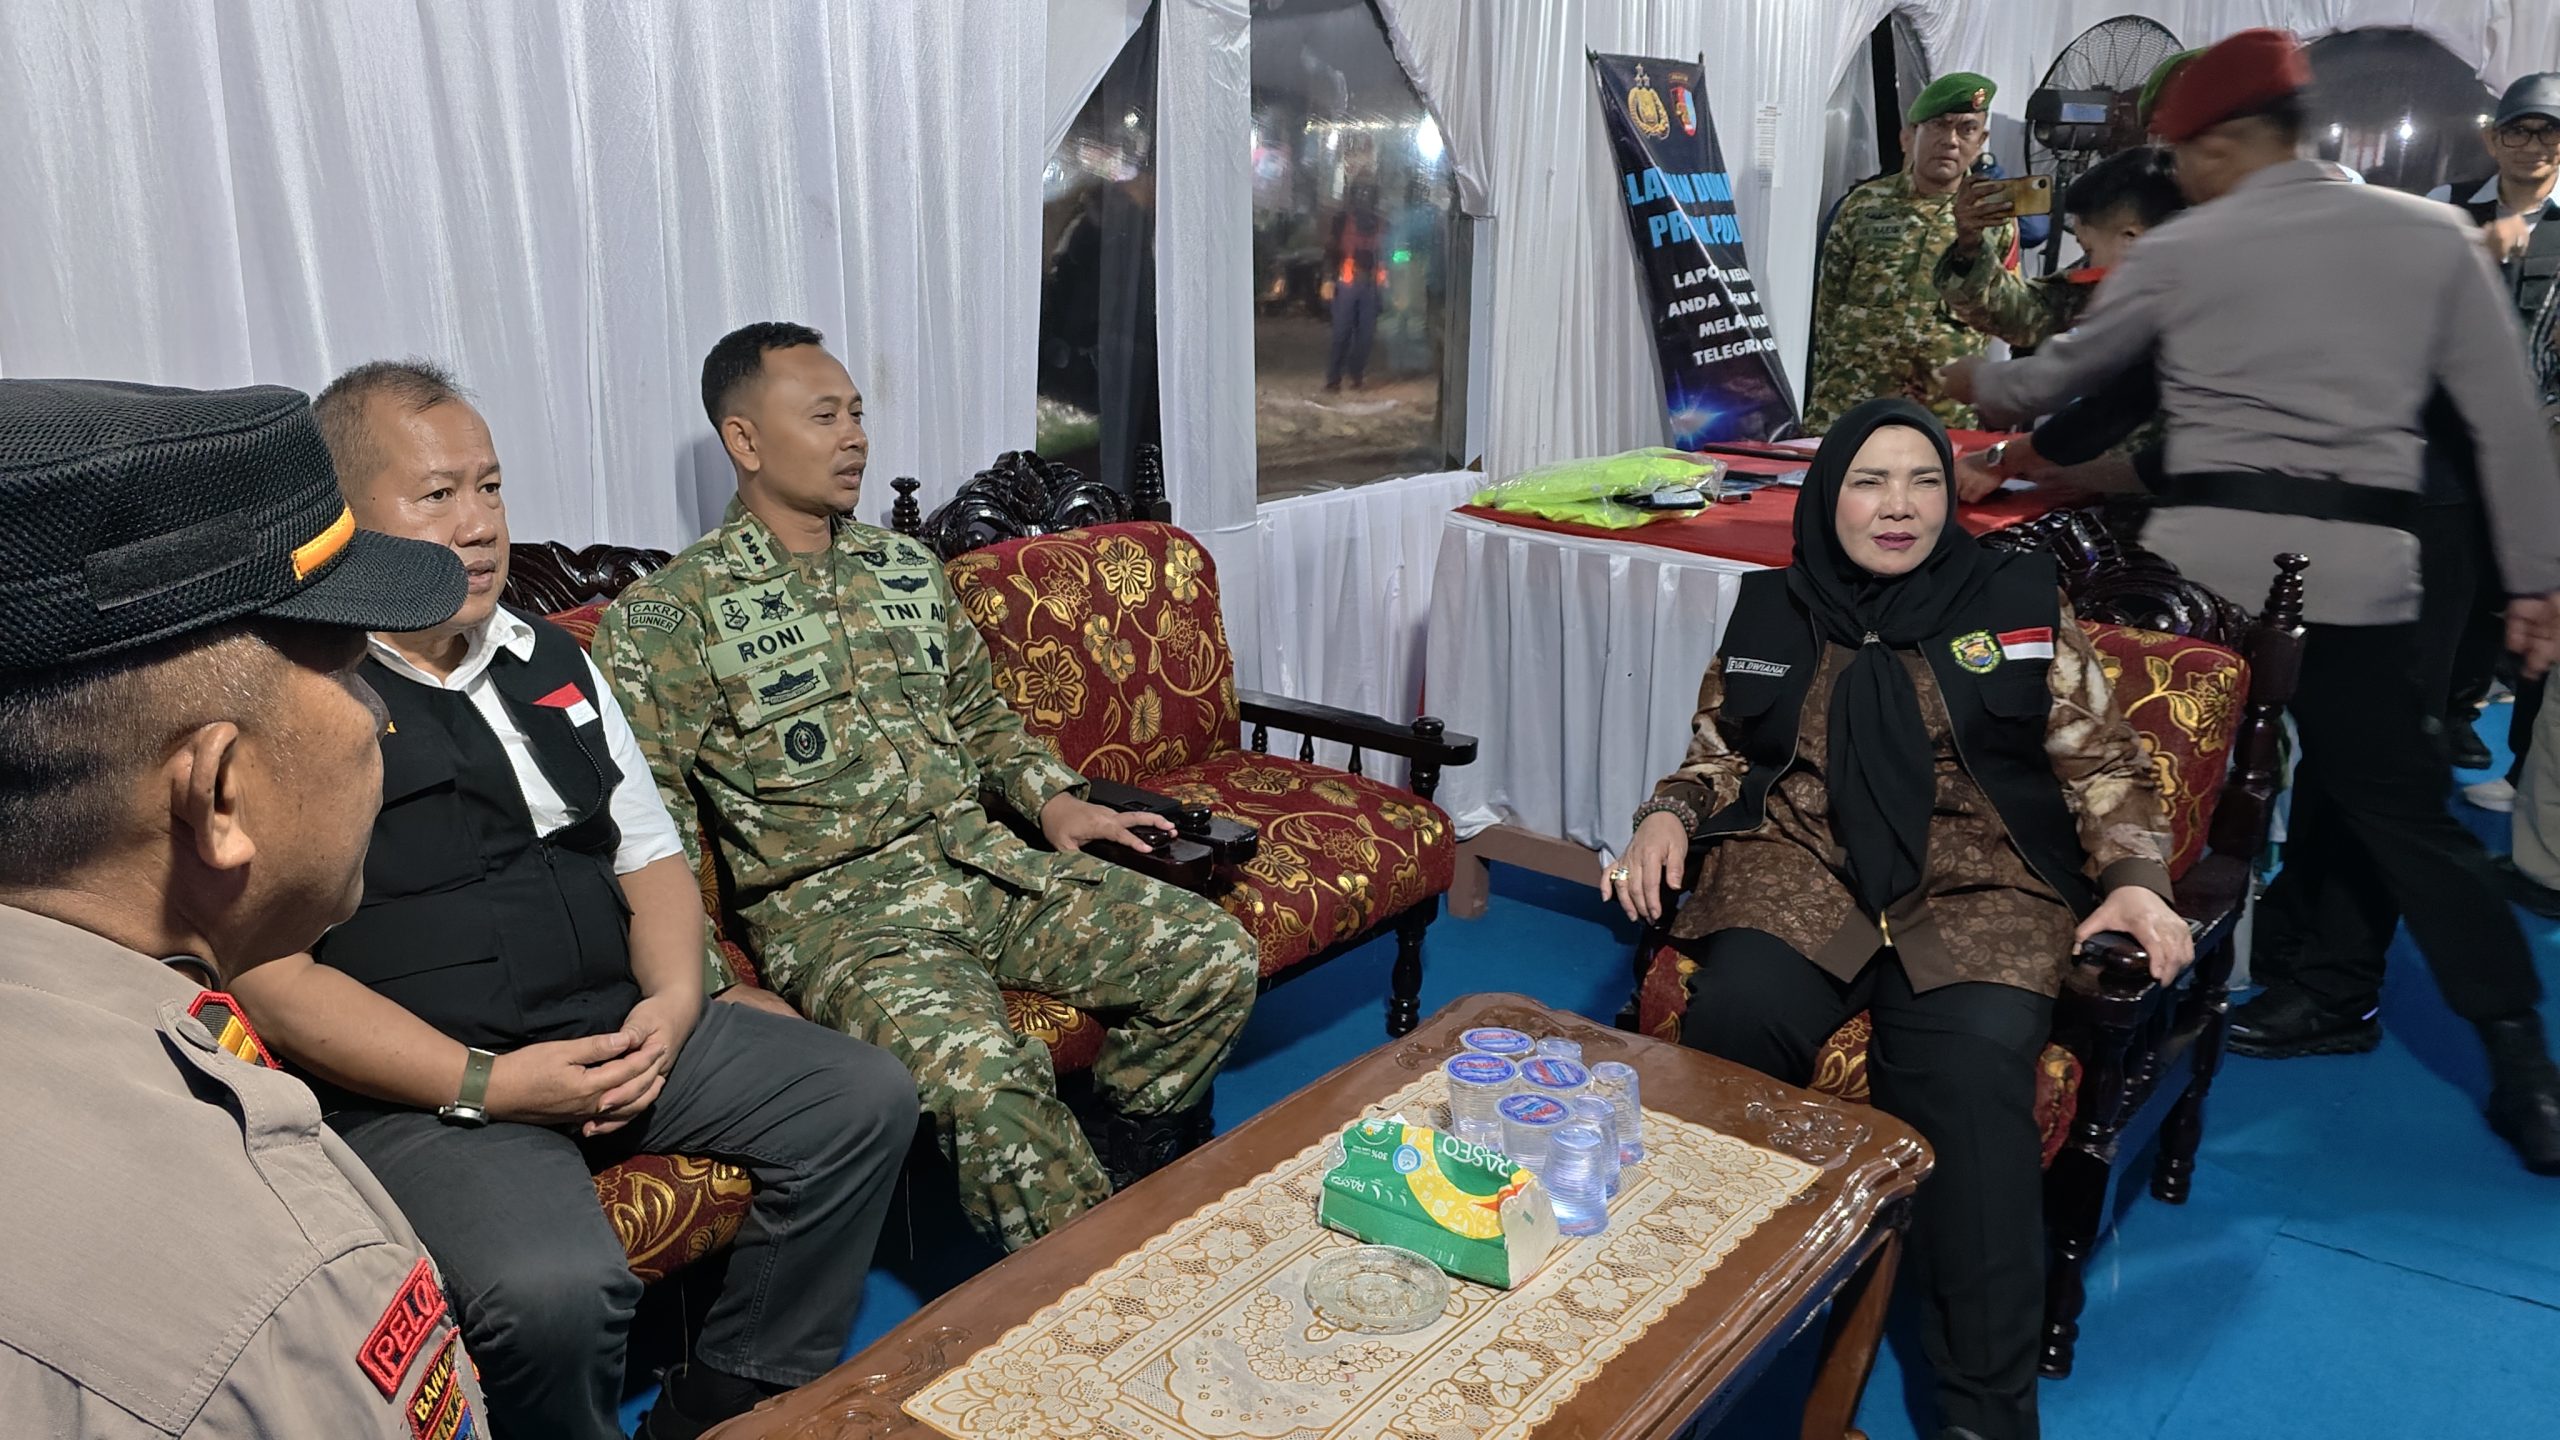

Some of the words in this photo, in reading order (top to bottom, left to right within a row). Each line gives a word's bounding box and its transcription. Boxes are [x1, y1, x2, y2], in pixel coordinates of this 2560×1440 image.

[1668, 293, 1720, 318] ANDA
[632, 602, 679, 620] CAKRA
[881, 603, 921, 621] TNI
[631, 615, 674, 632] GUNNER
[737, 625, 805, 663] RONI
[1729, 660, 1745, 670] EVA
[1745, 661, 1785, 674] DWIANA
